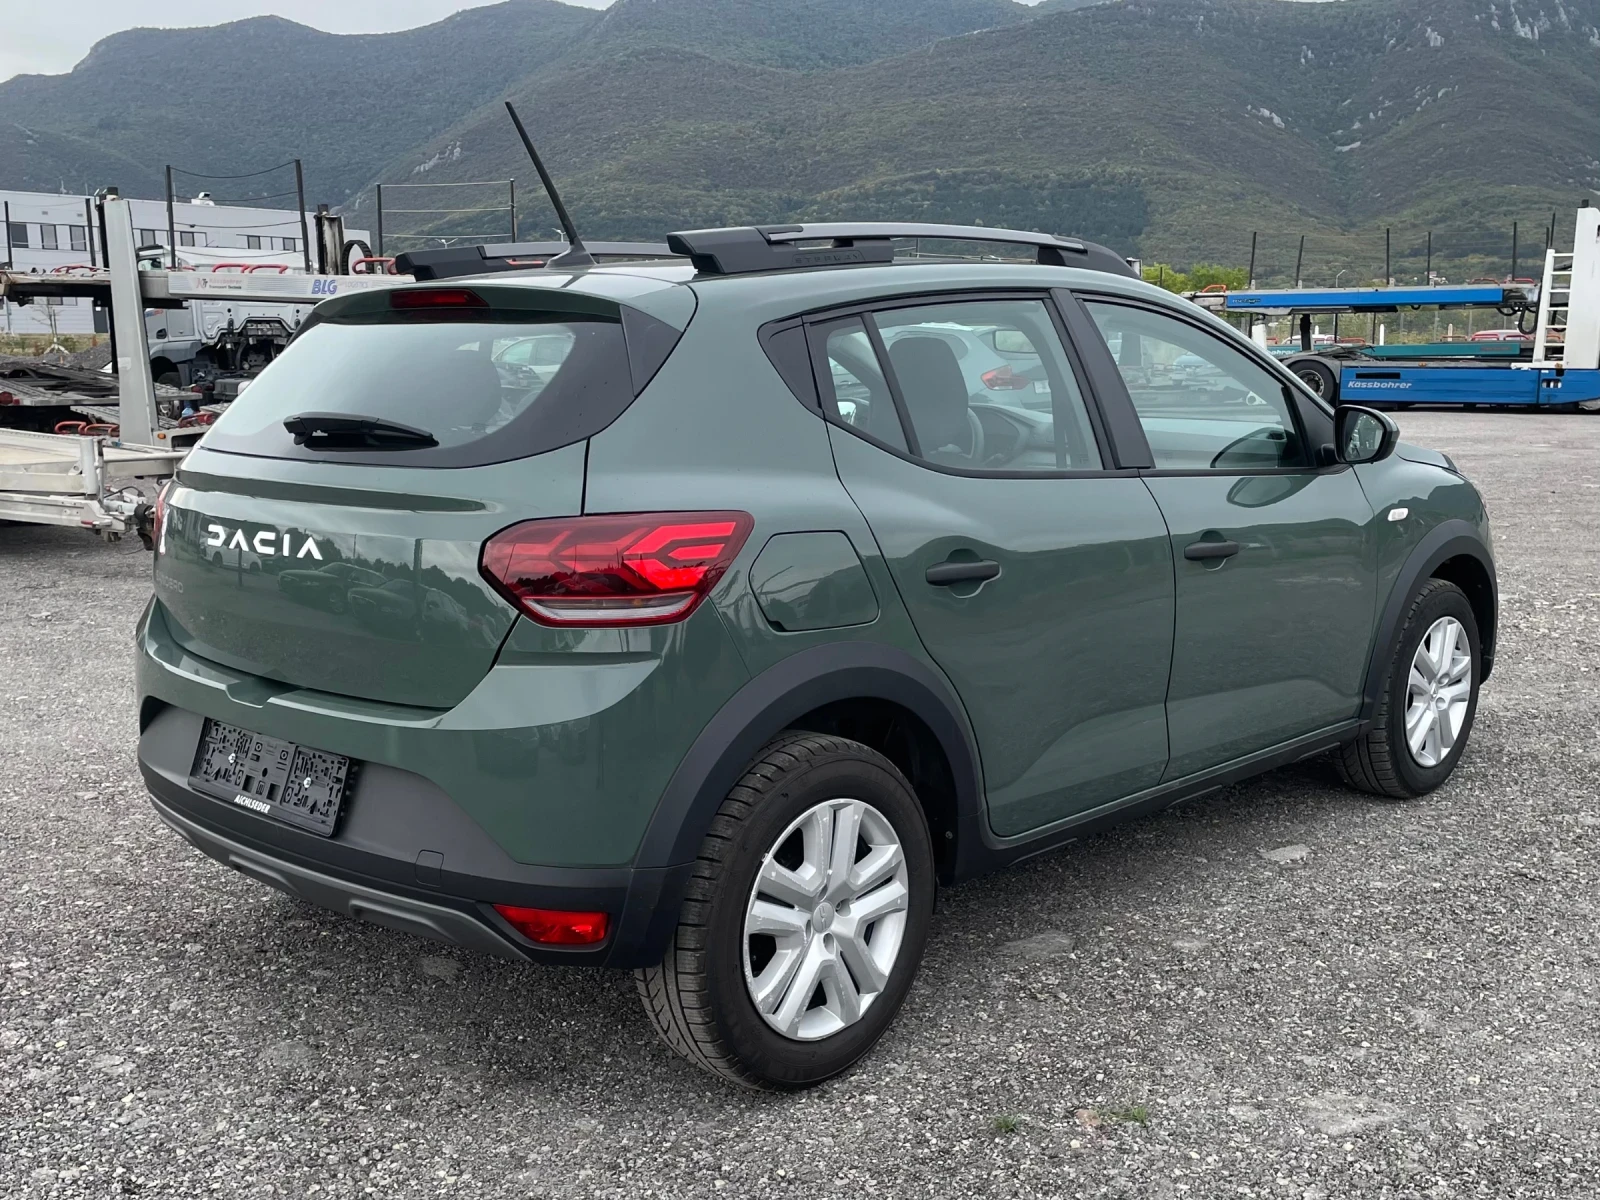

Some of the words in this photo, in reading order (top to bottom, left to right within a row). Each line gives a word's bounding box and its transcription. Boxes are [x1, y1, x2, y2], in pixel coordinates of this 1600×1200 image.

[311, 279, 338, 295] BLG
[1347, 381, 1412, 389] Kässbohrer
[207, 523, 324, 561] DACIA
